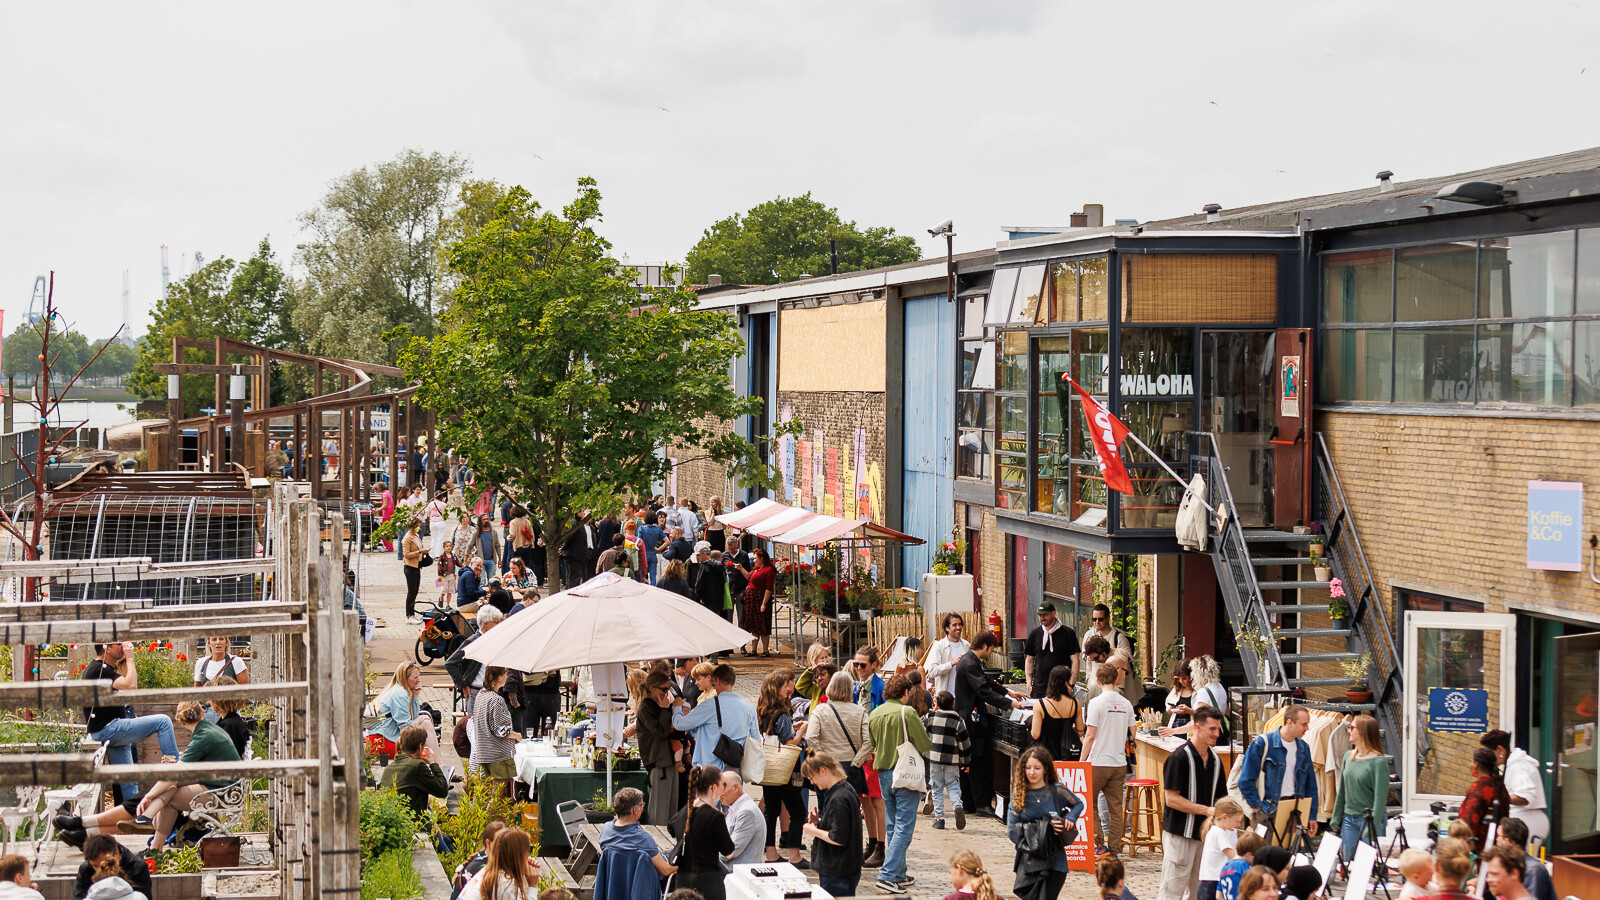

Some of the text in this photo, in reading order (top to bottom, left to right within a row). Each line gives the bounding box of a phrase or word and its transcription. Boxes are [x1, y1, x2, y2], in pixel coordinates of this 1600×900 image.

[1120, 374, 1194, 396] WALOHA
[1530, 510, 1573, 526] Koffie
[1530, 525, 1562, 541] &Co
